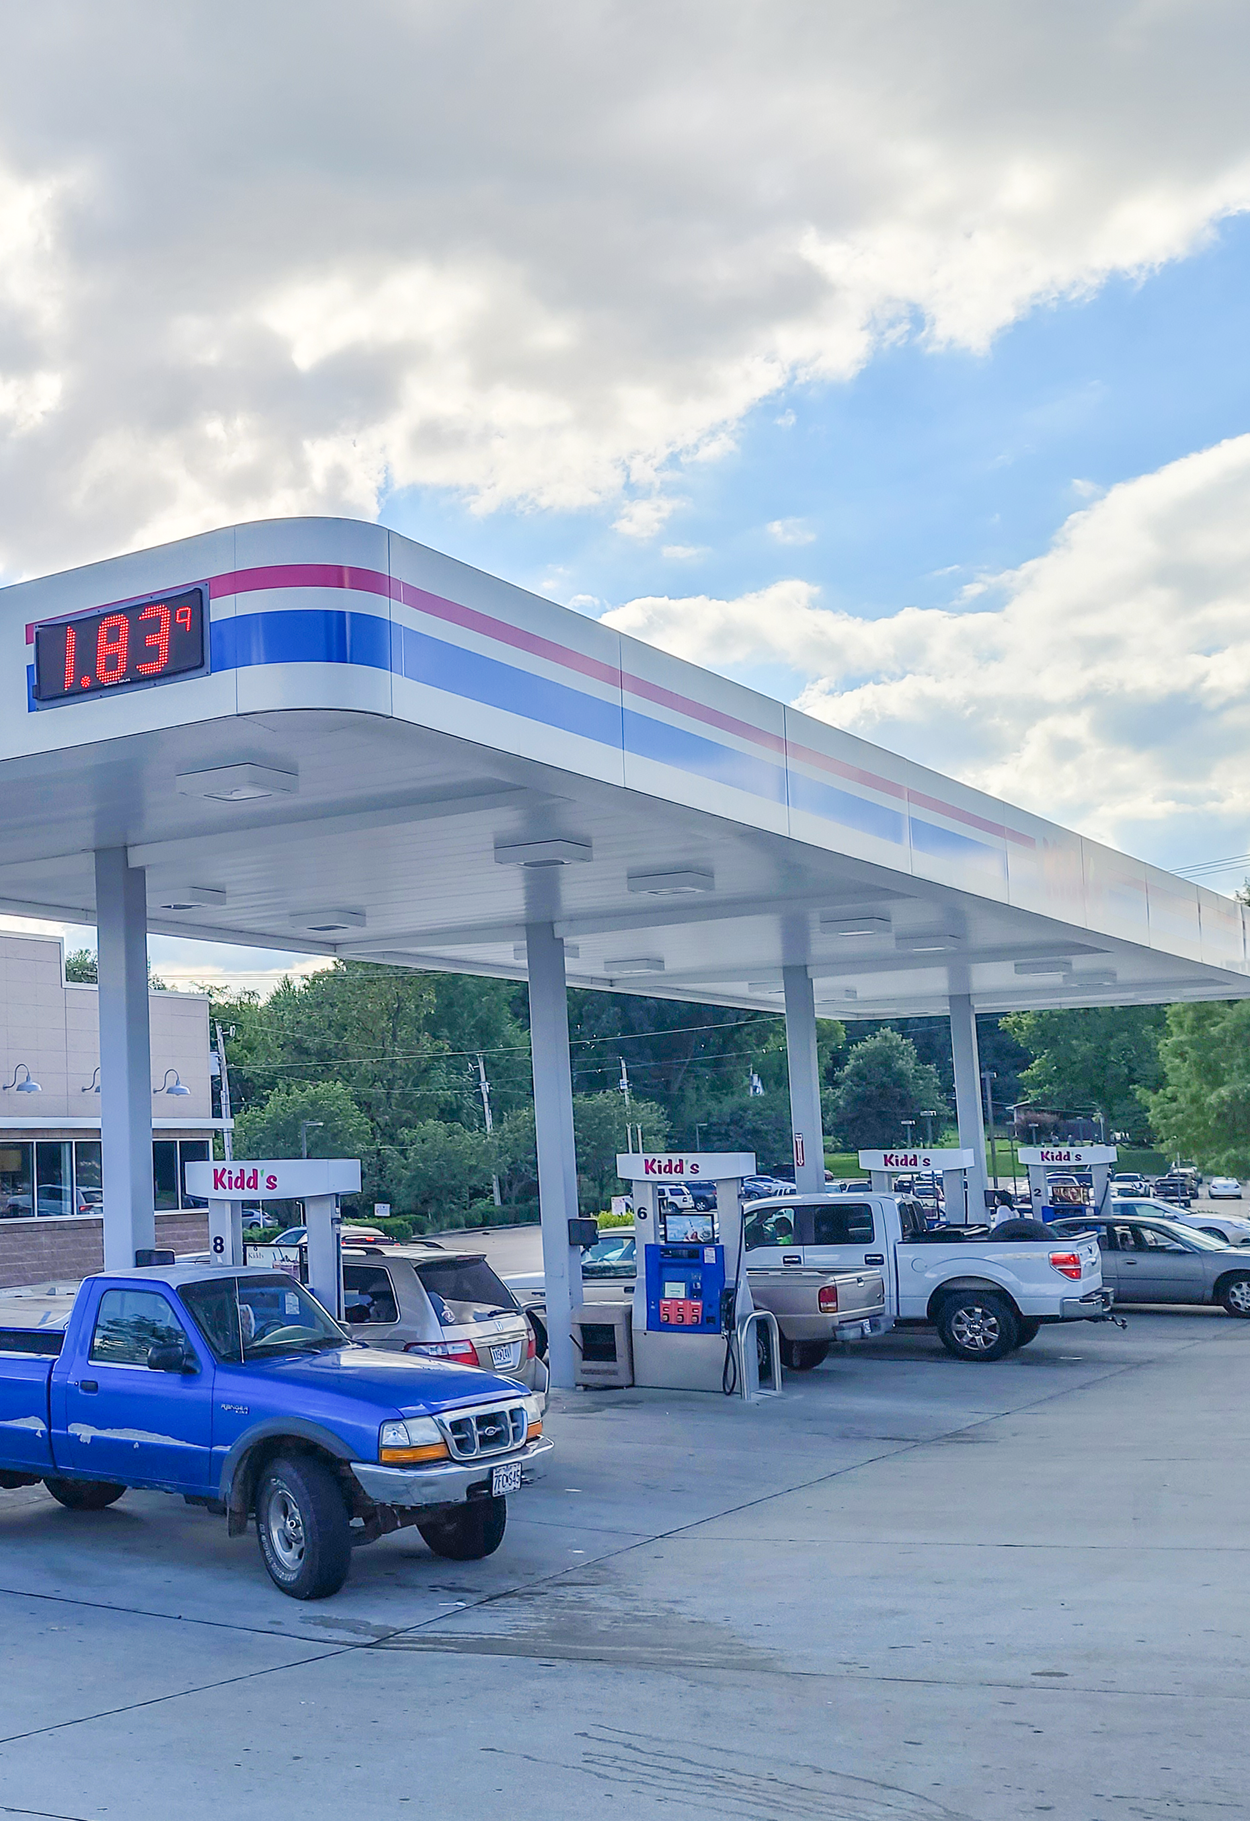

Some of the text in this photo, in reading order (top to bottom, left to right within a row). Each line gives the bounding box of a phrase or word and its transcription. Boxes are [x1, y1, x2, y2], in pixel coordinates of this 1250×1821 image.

[883, 1153, 932, 1168] Kidd's
[1040, 1150, 1083, 1162] Kidd's
[644, 1158, 700, 1175] Kidd's
[213, 1167, 278, 1191] Kidd's
[1033, 1188, 1042, 1197] 2
[637, 1206, 647, 1220] 6
[213, 1236, 224, 1254] 8
